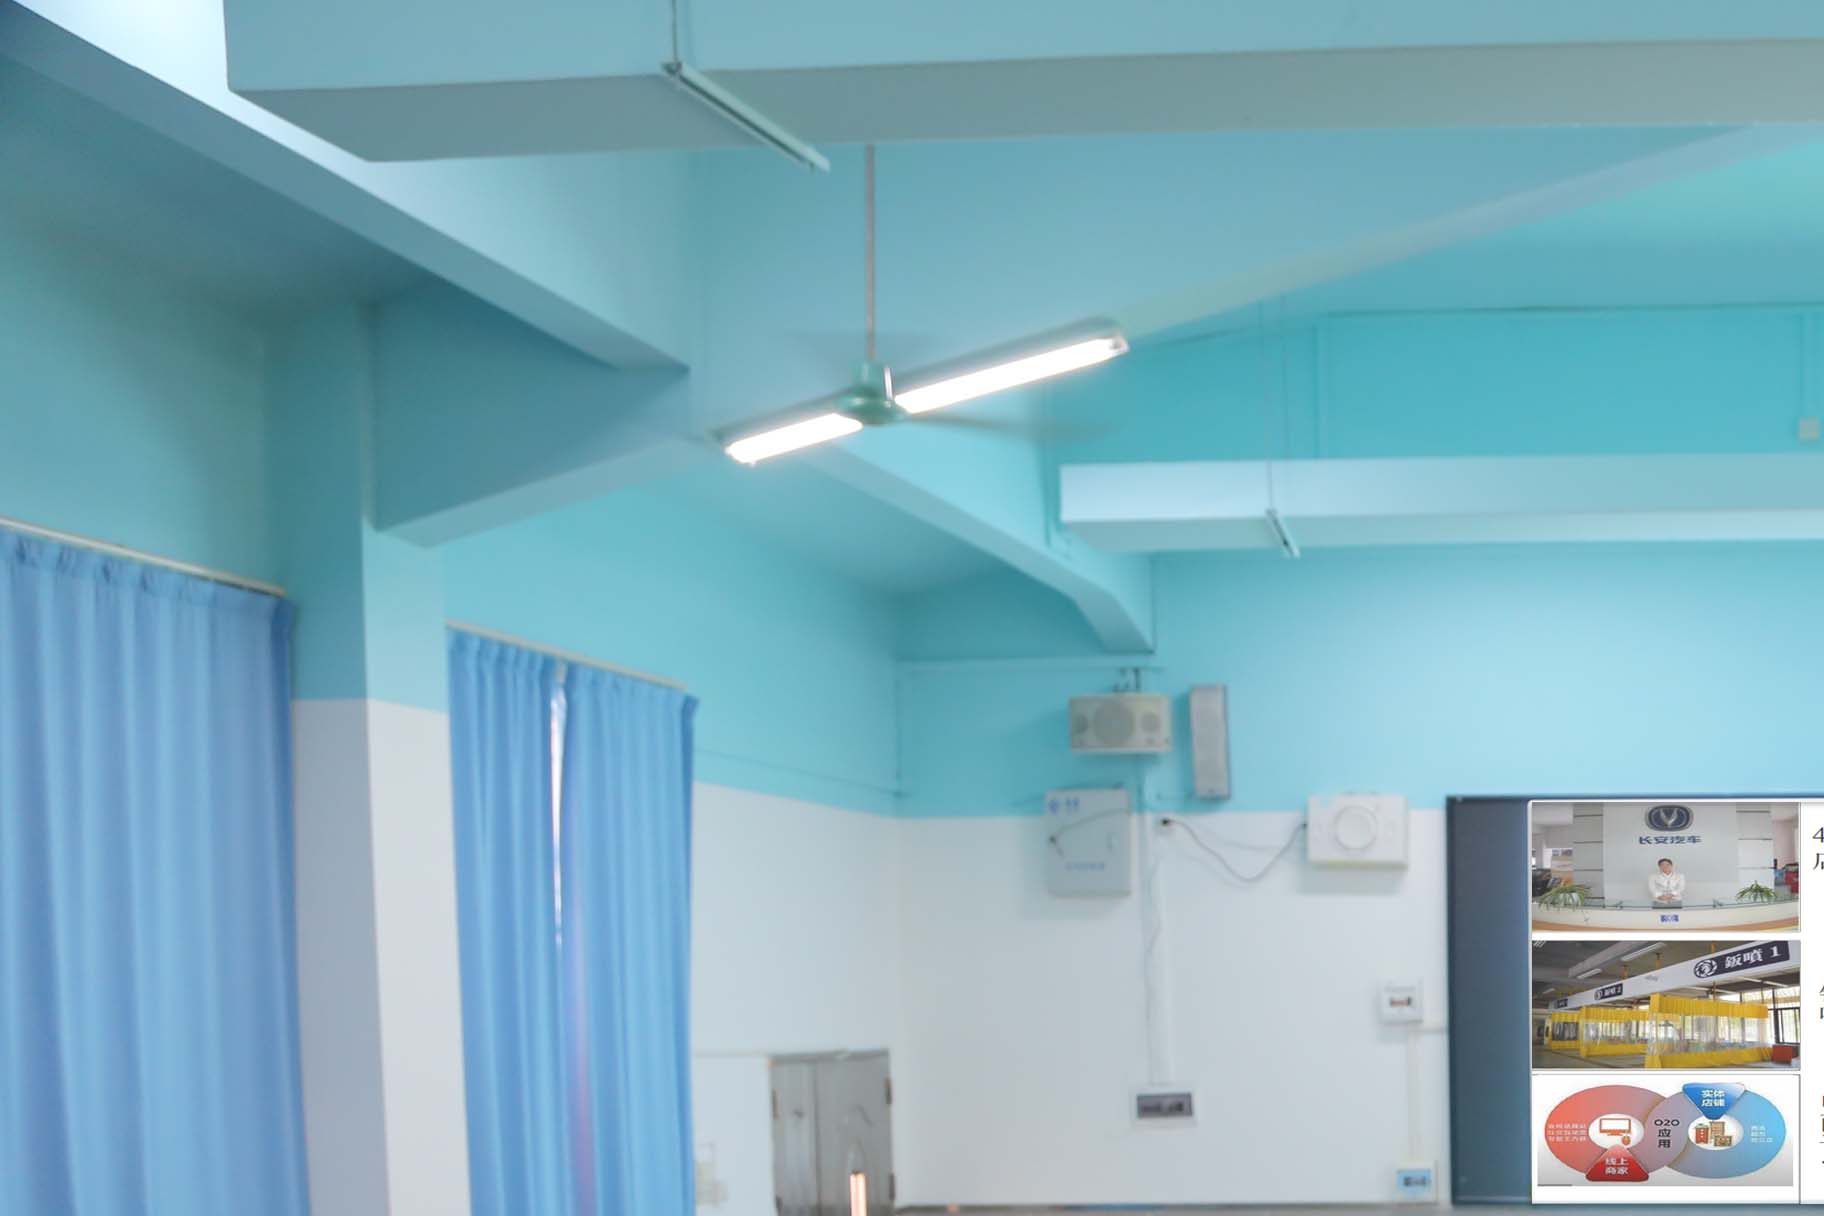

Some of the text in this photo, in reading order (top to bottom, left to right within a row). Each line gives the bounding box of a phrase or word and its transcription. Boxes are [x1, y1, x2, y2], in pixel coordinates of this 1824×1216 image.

[1639, 835, 1702, 845] 长安汽车
[1770, 945, 1782, 958] 1
[1701, 1089, 1725, 1099] 实体
[1654, 1119, 1680, 1127] O2O
[1657, 1128, 1672, 1149] 应用
[1605, 1157, 1629, 1166] 线上
